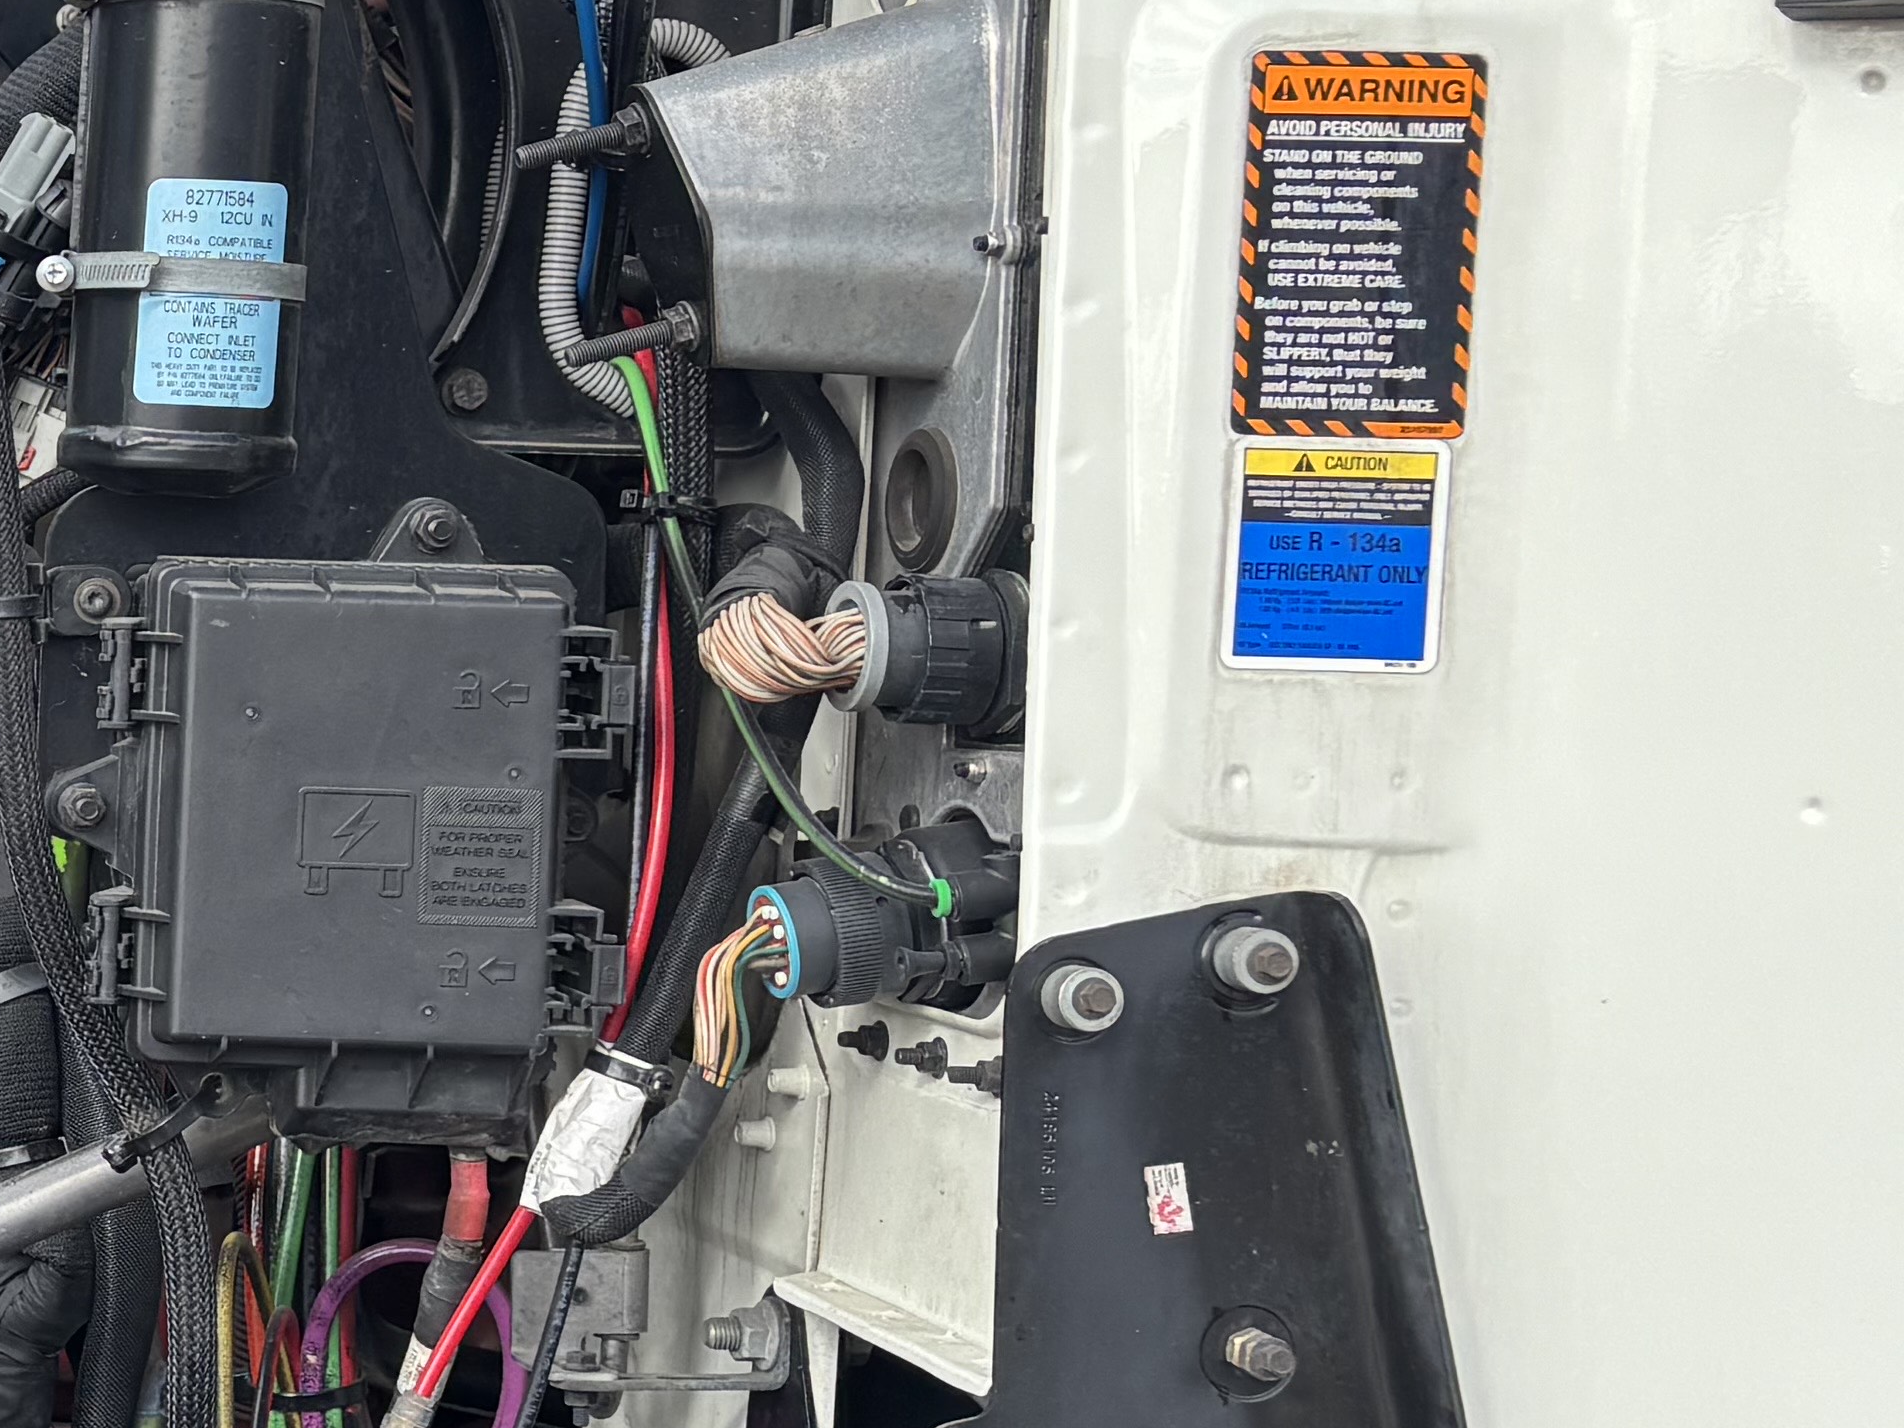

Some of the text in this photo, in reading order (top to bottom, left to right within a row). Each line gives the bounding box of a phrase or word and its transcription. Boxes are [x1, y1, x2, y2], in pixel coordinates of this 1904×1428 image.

[1304, 77, 1466, 104] WARNING
[1266, 120, 1466, 138] AVOID PERSONAL INJURY
[1263, 149, 1423, 164] STAND ON THE GROUND
[1274, 167, 1396, 182] when servicing or
[1273, 183, 1419, 199] cleaning components
[1272, 200, 1374, 216] on this vehicle,
[162, 210, 272, 227] XH-9 12CU IN
[1271, 217, 1338, 229] whenever
[208, 236, 272, 249] COMPATIBLE
[1258, 239, 1402, 255] If climbing on vehicle
[1268, 258, 1316, 270] cannot
[1318, 258, 1337, 270] be
[1268, 274, 1295, 286] USE
[1297, 274, 1362, 287] EXTREME
[164, 300, 260, 317] CONTAINS TRACER
[1254, 296, 1412, 314] Before you grab or step
[192, 315, 238, 329] WAFER
[1265, 316, 1427, 330] on components, be sure
[167, 332, 256, 347] CONNECT INLET
[1264, 331, 1394, 345] they are not HOT or
[167, 347, 255, 362] TO CONDENSER
[1263, 347, 1394, 364] SLIPPERY, that they
[1262, 363, 1427, 381] will support your weight
[1261, 380, 1372, 395] and allow you to
[1260, 396, 1439, 412] MAINTAIN YOUR BALANCE.
[1325, 456, 1388, 471] CAUTION
[1269, 535, 1301, 550] USE
[1309, 531, 1323, 551] R
[1348, 532, 1401, 553] 134a
[1242, 562, 1427, 584] REFRIGERANT ONLY
[463, 802, 522, 815] CAUTION
[439, 832, 523, 843] FOR PROPER
[430, 846, 494, 857] WEATHER
[453, 867, 506, 878] ENSURE
[430, 881, 527, 893] BOTH LATCHES
[432, 895, 526, 908] ARE ENGAGED
